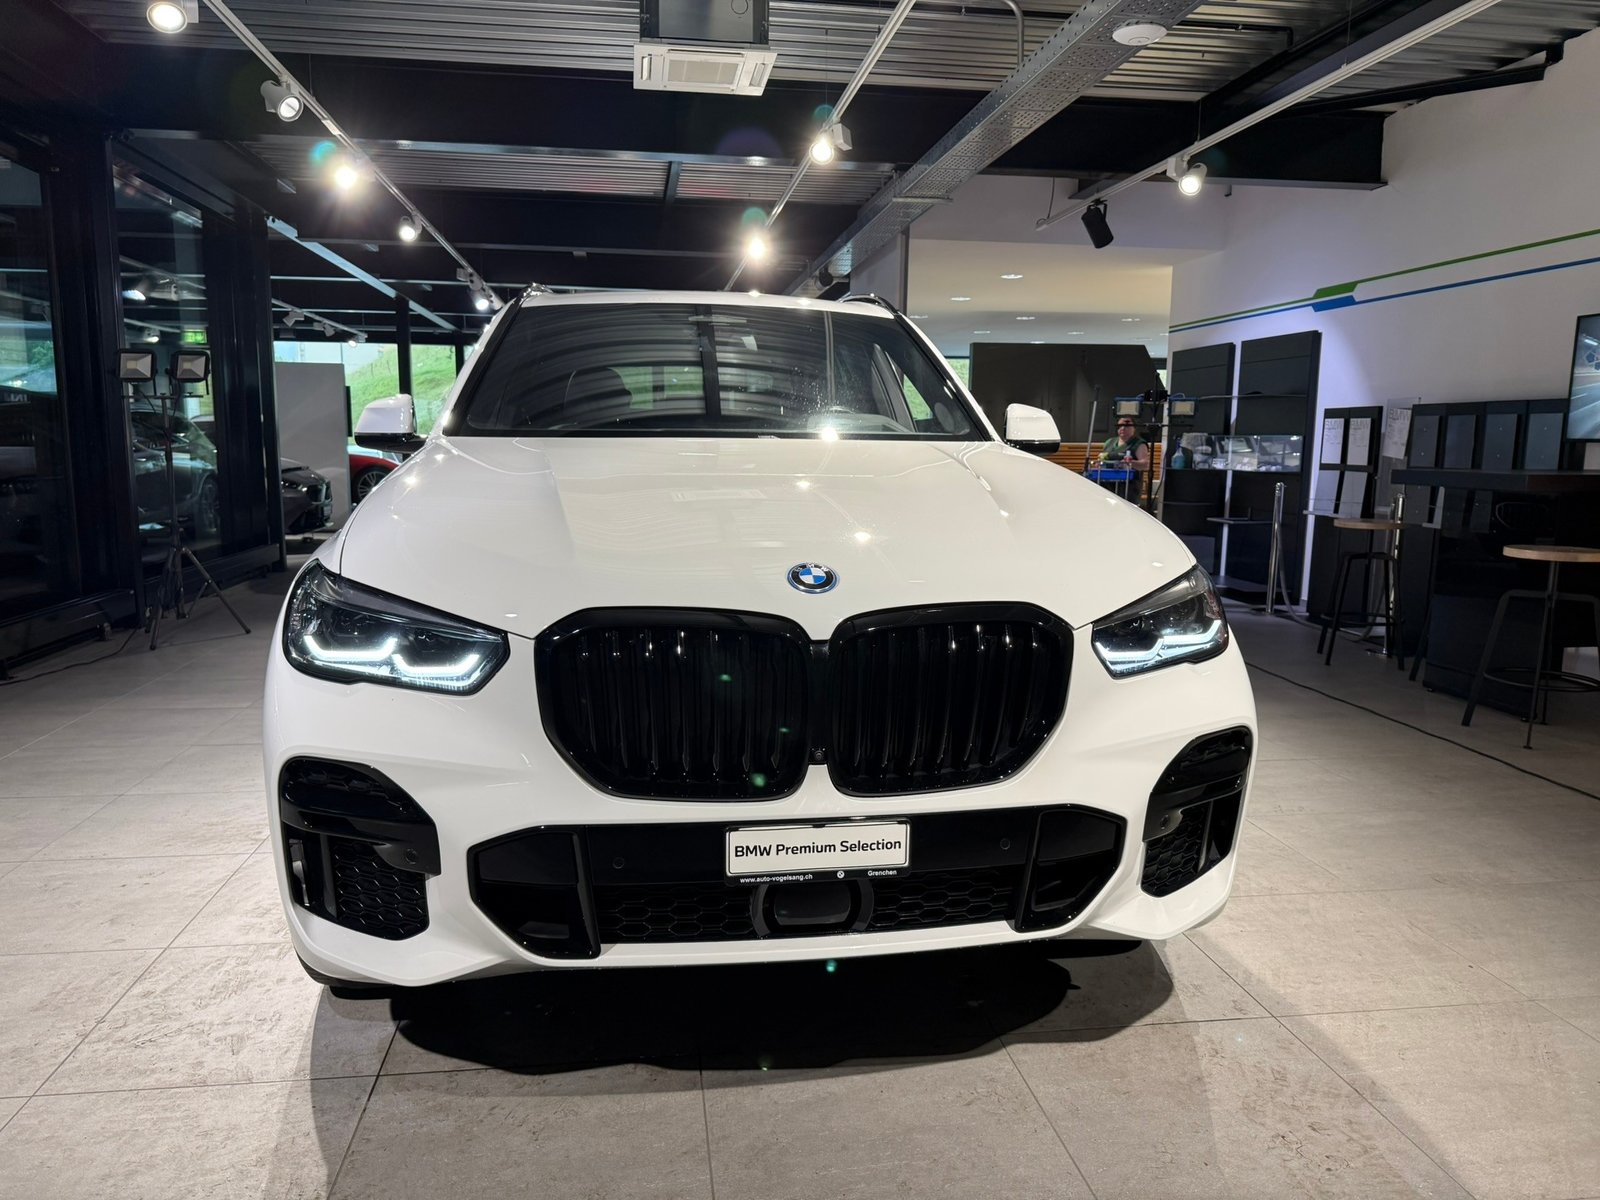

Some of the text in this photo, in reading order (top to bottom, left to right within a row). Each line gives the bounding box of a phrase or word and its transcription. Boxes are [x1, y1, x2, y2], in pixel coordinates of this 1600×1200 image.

[735, 838, 902, 857] BMW Premium Selection
[867, 869, 898, 877] Grenchen
[740, 874, 813, 884] www.auto-vogelsang.ch
